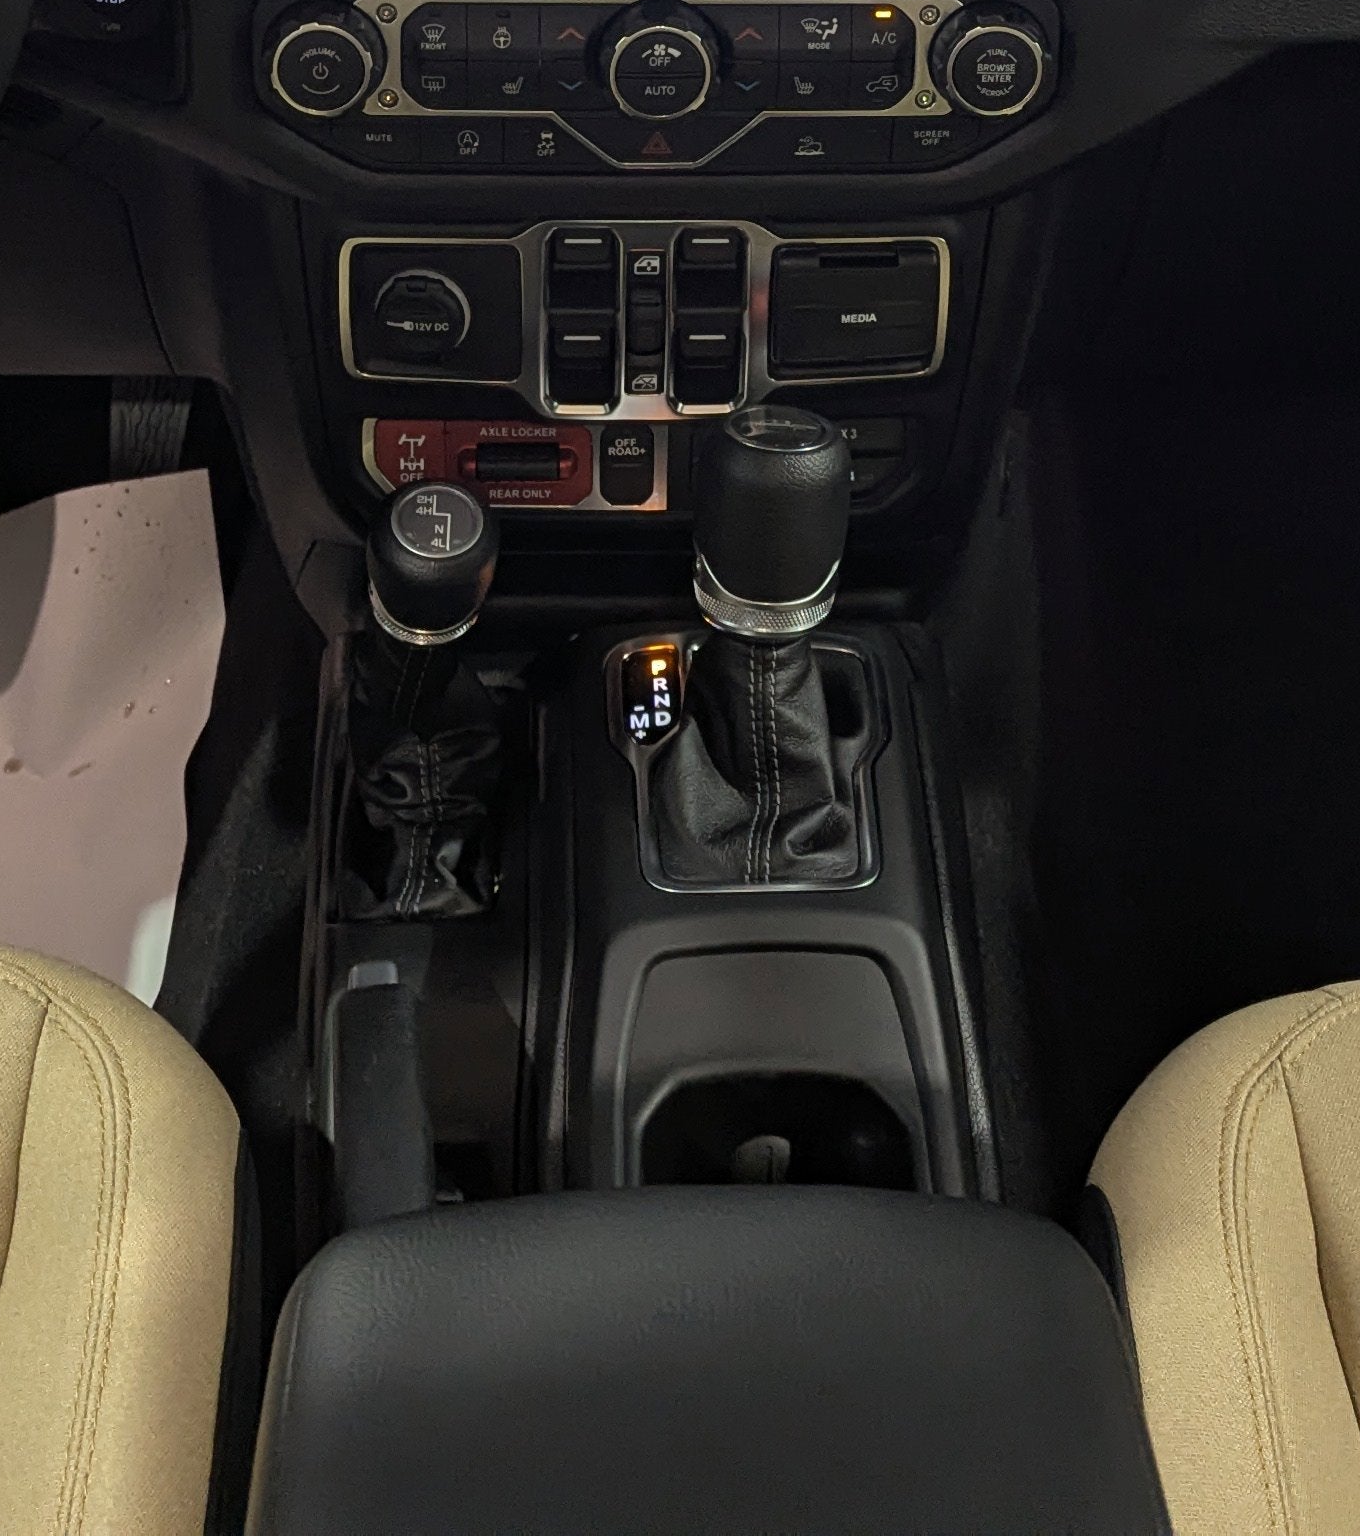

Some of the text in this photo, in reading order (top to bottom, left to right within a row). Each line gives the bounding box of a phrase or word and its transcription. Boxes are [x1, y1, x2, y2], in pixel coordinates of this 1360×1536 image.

[871, 32, 897, 45] A/C
[421, 41, 447, 51] FRONT
[808, 41, 830, 50] MODE
[305, 47, 336, 58] VOLUME
[988, 48, 1008, 58] TUNE
[648, 57, 671, 67] OFF
[977, 63, 1016, 73] BROWSE
[981, 73, 1012, 84] ENTER
[644, 85, 676, 96] AUTO
[979, 86, 1010, 98] SCROLL
[365, 133, 392, 143] MUTE
[913, 130, 950, 138] SCREEN
[921, 138, 940, 146] OFF
[459, 147, 477, 156] OFF
[537, 148, 555, 157] OFF
[841, 313, 877, 324] MEDIA
[415, 322, 449, 331] 12V DC
[479, 427, 556, 437] AXLE LOCKER
[615, 438, 636, 447] OFF
[608, 446, 646, 456] ROAD+
[400, 472, 424, 482] OFF
[490, 489, 551, 499] REAR ONLY
[416, 495, 433, 504] 2H
[416, 507, 433, 516] 4H
[434, 524, 443, 533] N
[431, 538, 446, 548] 4L
[651, 659, 666, 675] P
[653, 678, 667, 692] R
[654, 694, 670, 708] N
[630, 713, 649, 729] M
[655, 711, 671, 726] D
